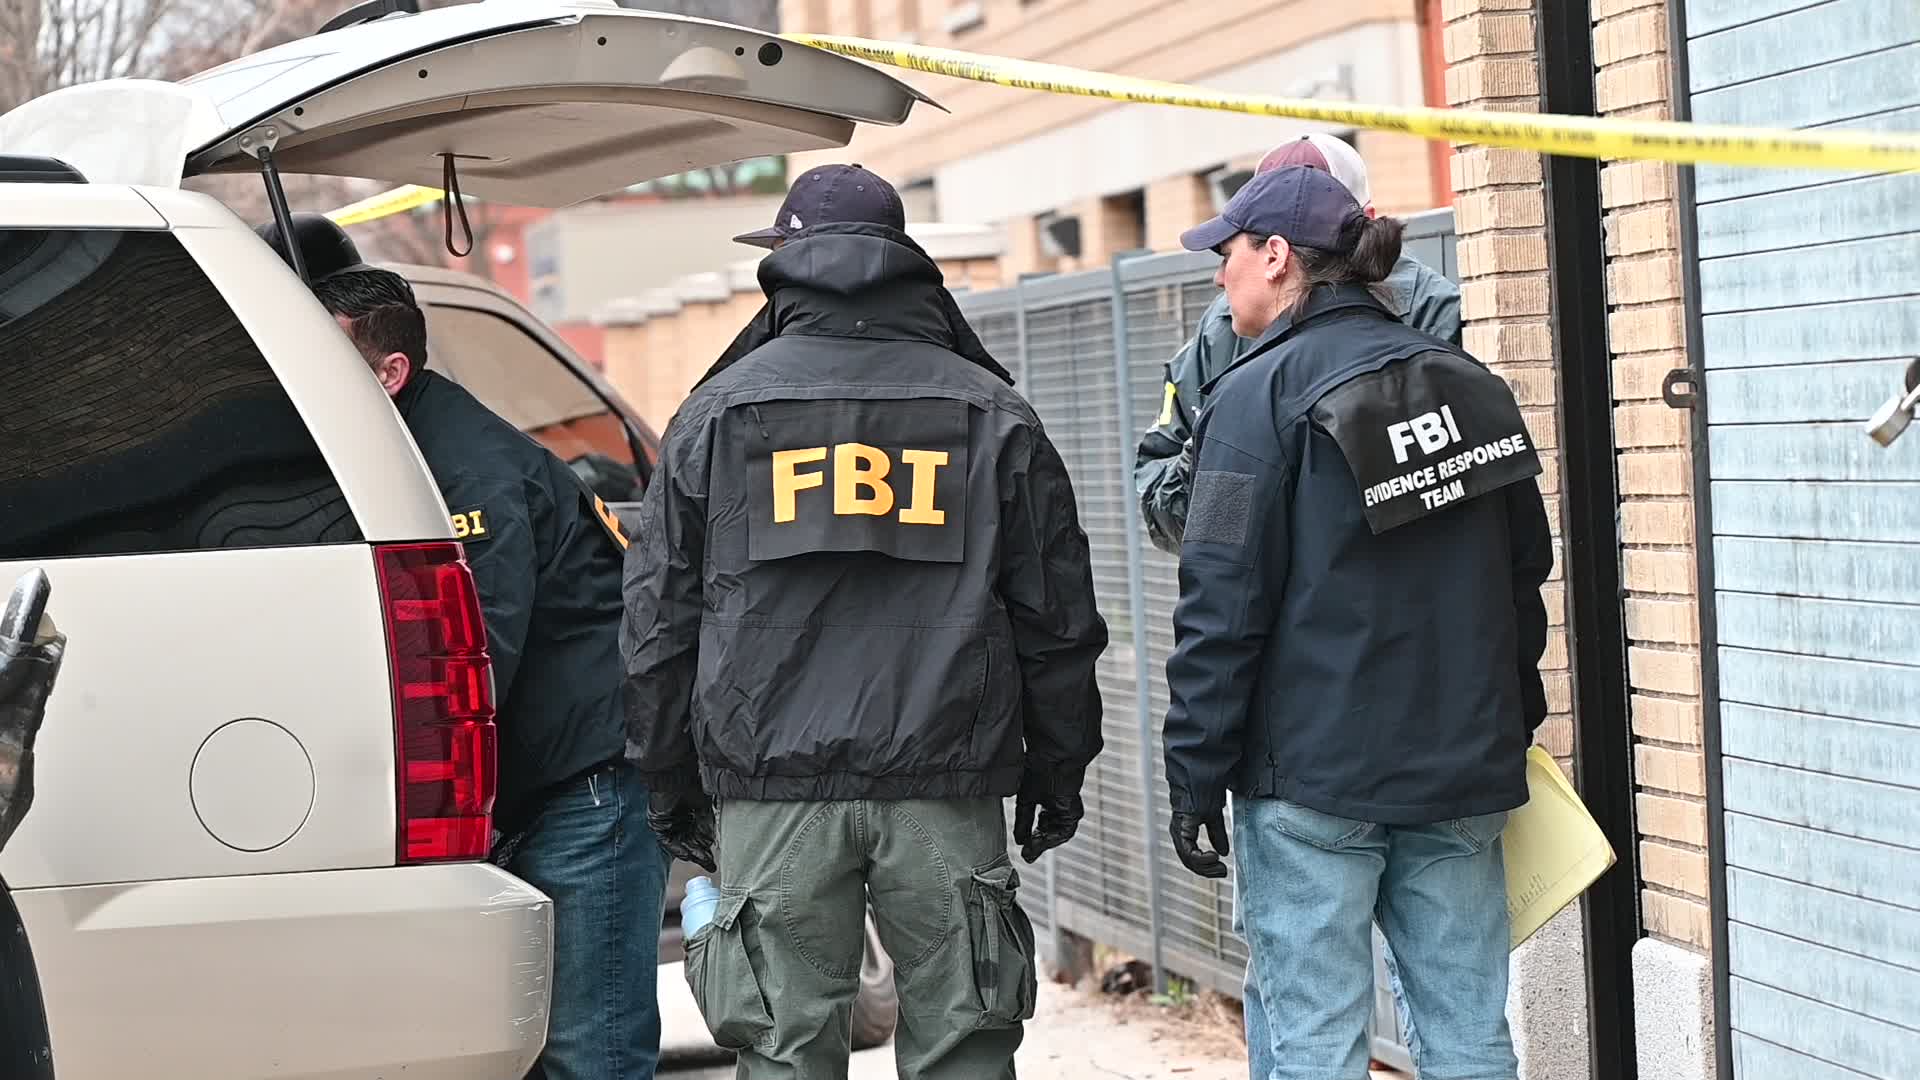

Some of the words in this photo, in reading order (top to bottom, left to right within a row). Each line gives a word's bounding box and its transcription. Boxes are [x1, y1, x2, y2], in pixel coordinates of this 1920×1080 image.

[1387, 404, 1462, 464] FBI
[772, 442, 948, 525] FBI
[1364, 466, 1437, 507] EVIDENCE
[1438, 433, 1527, 481] RESPONSE
[1420, 479, 1465, 510] TEAM
[451, 510, 485, 537] BI
